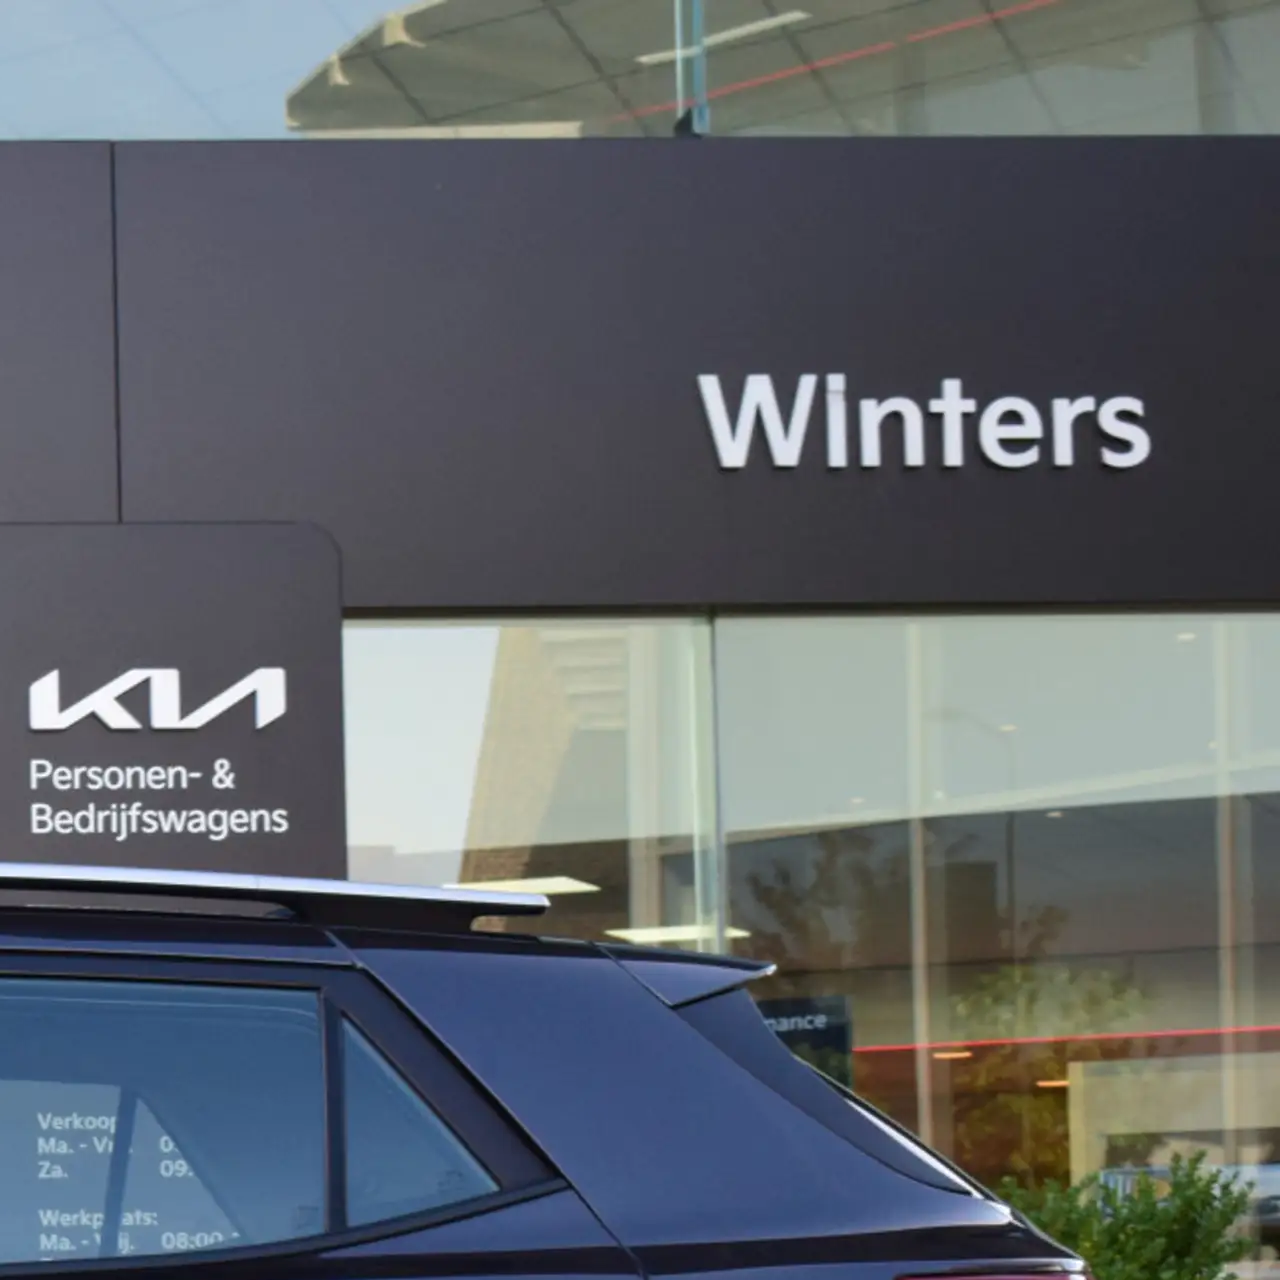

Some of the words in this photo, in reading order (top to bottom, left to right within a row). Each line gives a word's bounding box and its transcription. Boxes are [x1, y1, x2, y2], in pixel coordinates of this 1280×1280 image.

[697, 373, 1152, 468] Winters
[29, 667, 286, 730] KIA
[30, 758, 202, 790] Personen-
[211, 758, 235, 789] &
[30, 803, 289, 841] Bedrijfswagens
[37, 1136, 74, 1154] Ma.
[37, 1160, 69, 1179] Za.
[39, 1233, 77, 1251] Ma.
